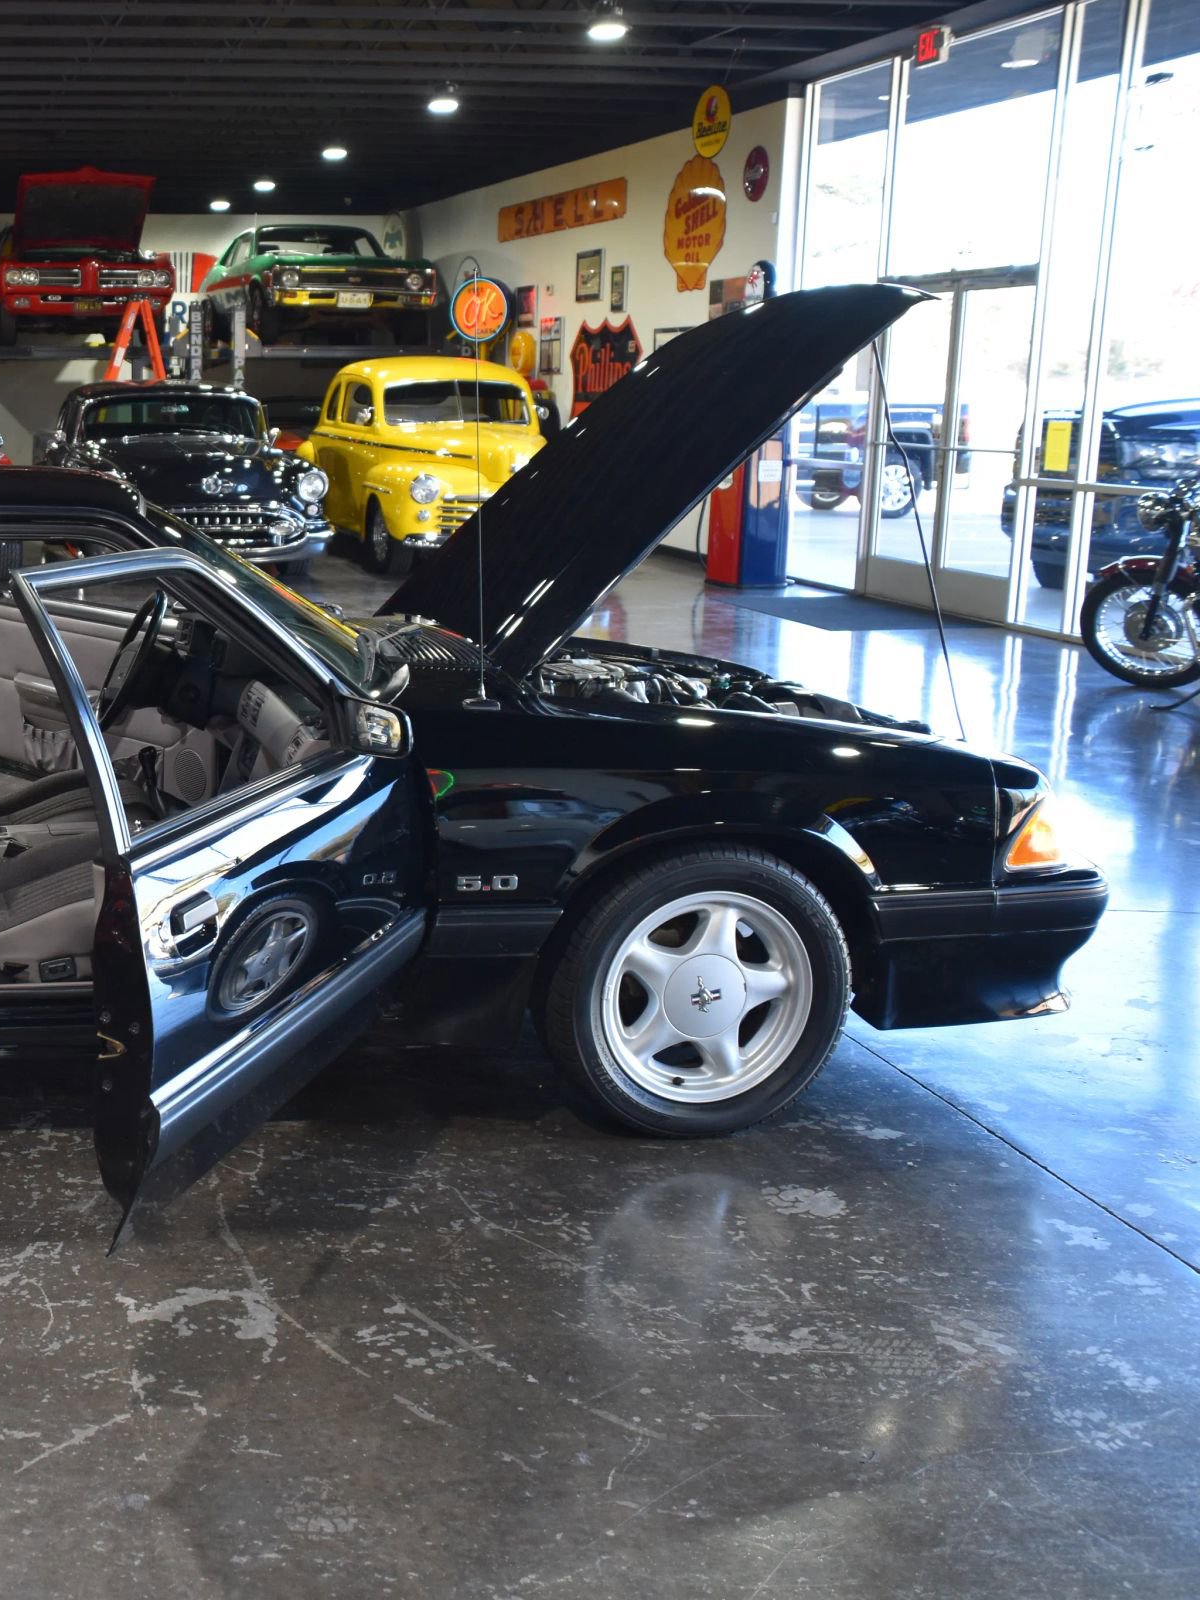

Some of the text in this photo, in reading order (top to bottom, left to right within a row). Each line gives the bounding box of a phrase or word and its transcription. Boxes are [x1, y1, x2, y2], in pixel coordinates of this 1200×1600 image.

[513, 187, 604, 236] SHELL
[684, 198, 719, 236] SHELL
[677, 233, 711, 250] MOTOR
[684, 251, 700, 262] OIL
[463, 288, 503, 328] OK
[191, 311, 202, 385] BENDPA
[456, 874, 518, 892] 5.0
